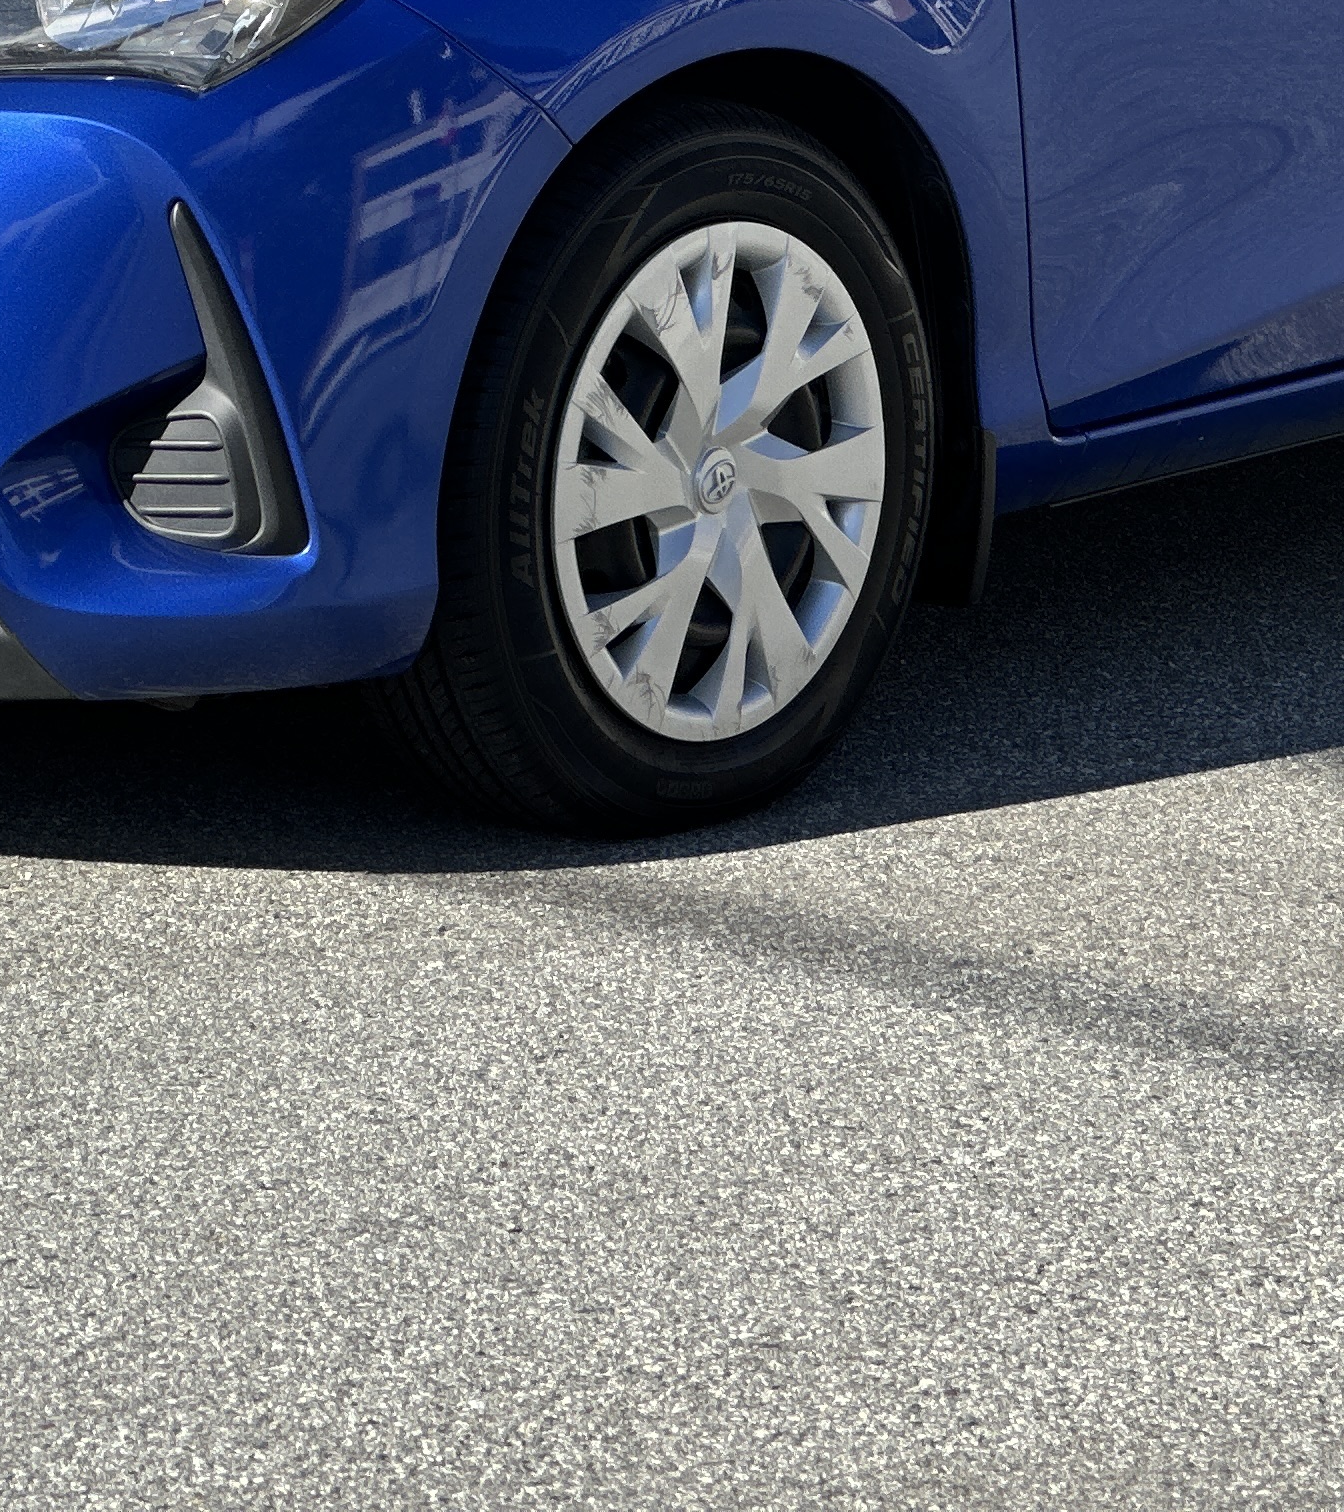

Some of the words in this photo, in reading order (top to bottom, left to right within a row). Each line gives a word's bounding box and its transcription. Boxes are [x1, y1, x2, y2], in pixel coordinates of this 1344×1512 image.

[727, 172, 813, 202] 175/65R15
[509, 387, 546, 589] AllTrek
[890, 331, 928, 607] CERTIFIED
